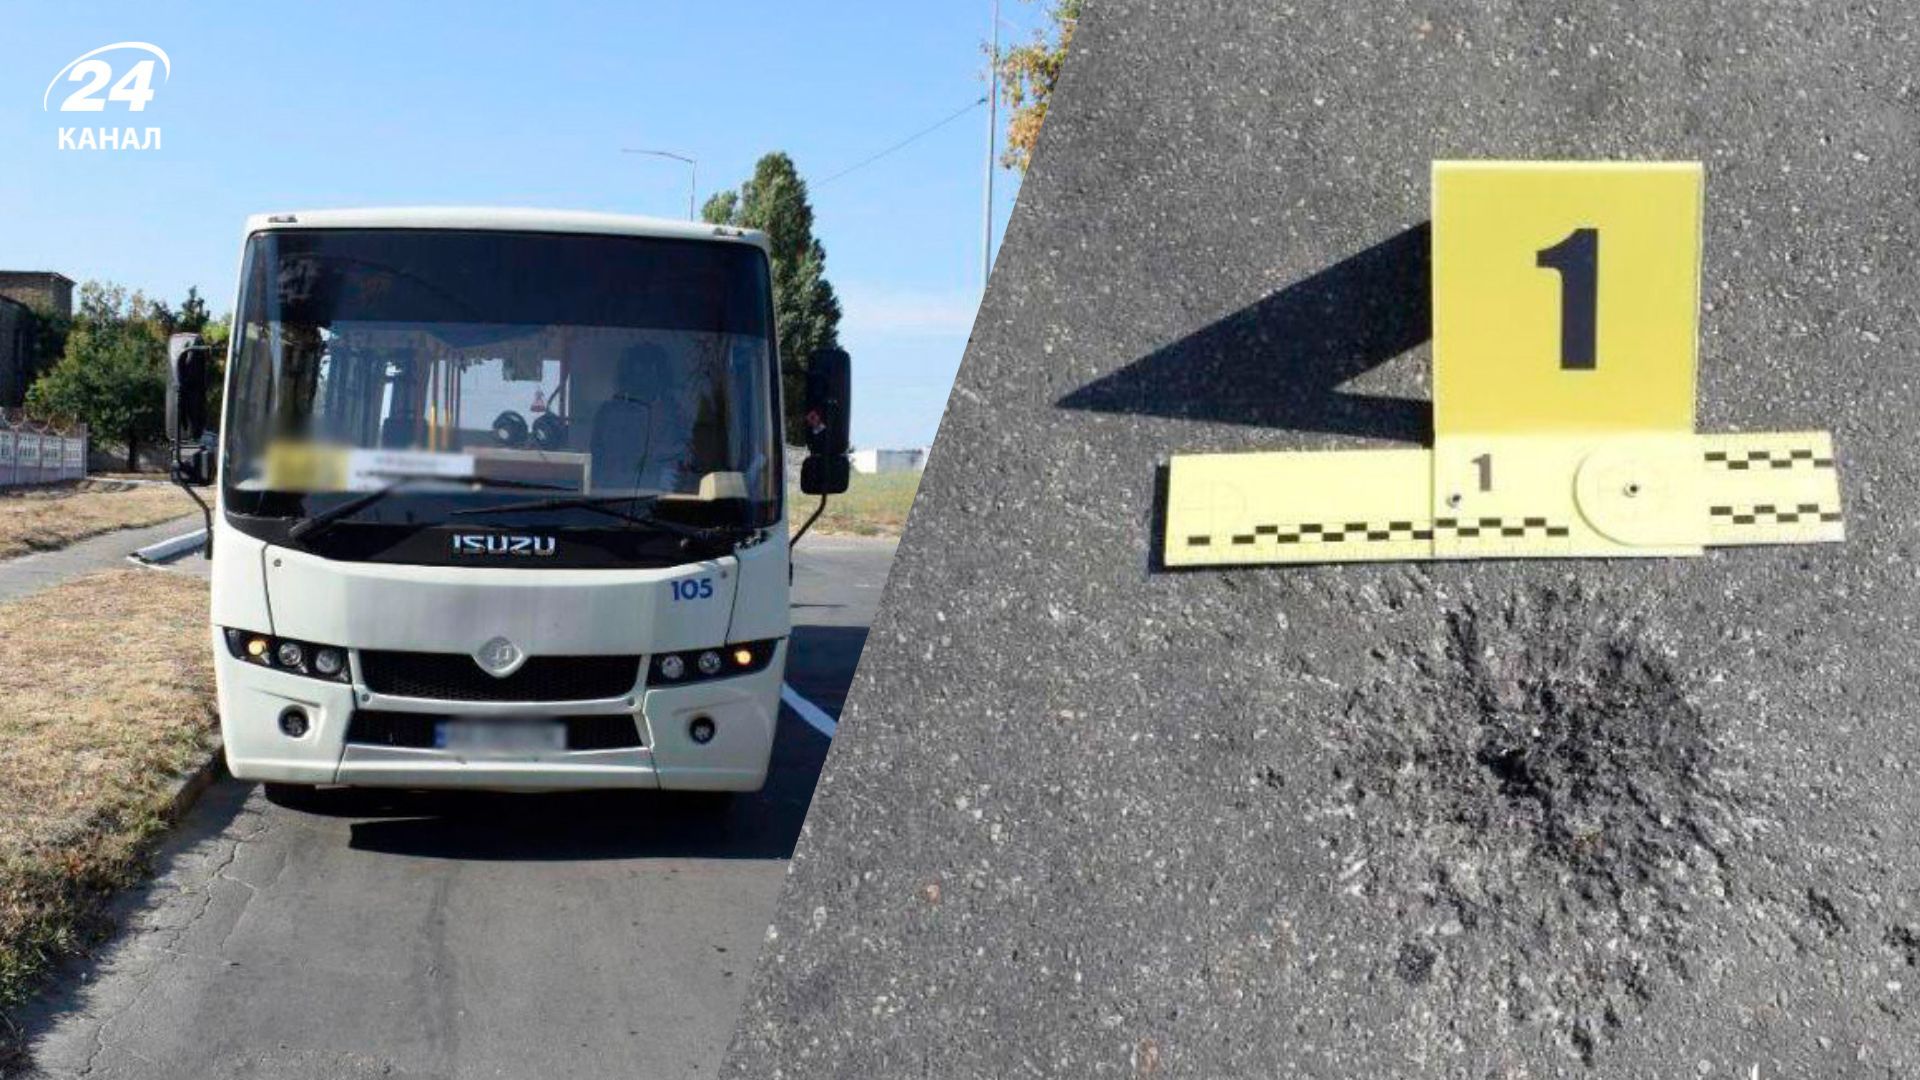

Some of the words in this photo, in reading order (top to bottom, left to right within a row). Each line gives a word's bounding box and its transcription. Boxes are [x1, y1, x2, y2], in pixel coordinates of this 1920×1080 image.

[1536, 228, 1598, 370] 1
[1471, 453, 1491, 492] 1
[453, 534, 556, 556] ISUZU
[670, 578, 714, 601] 105
